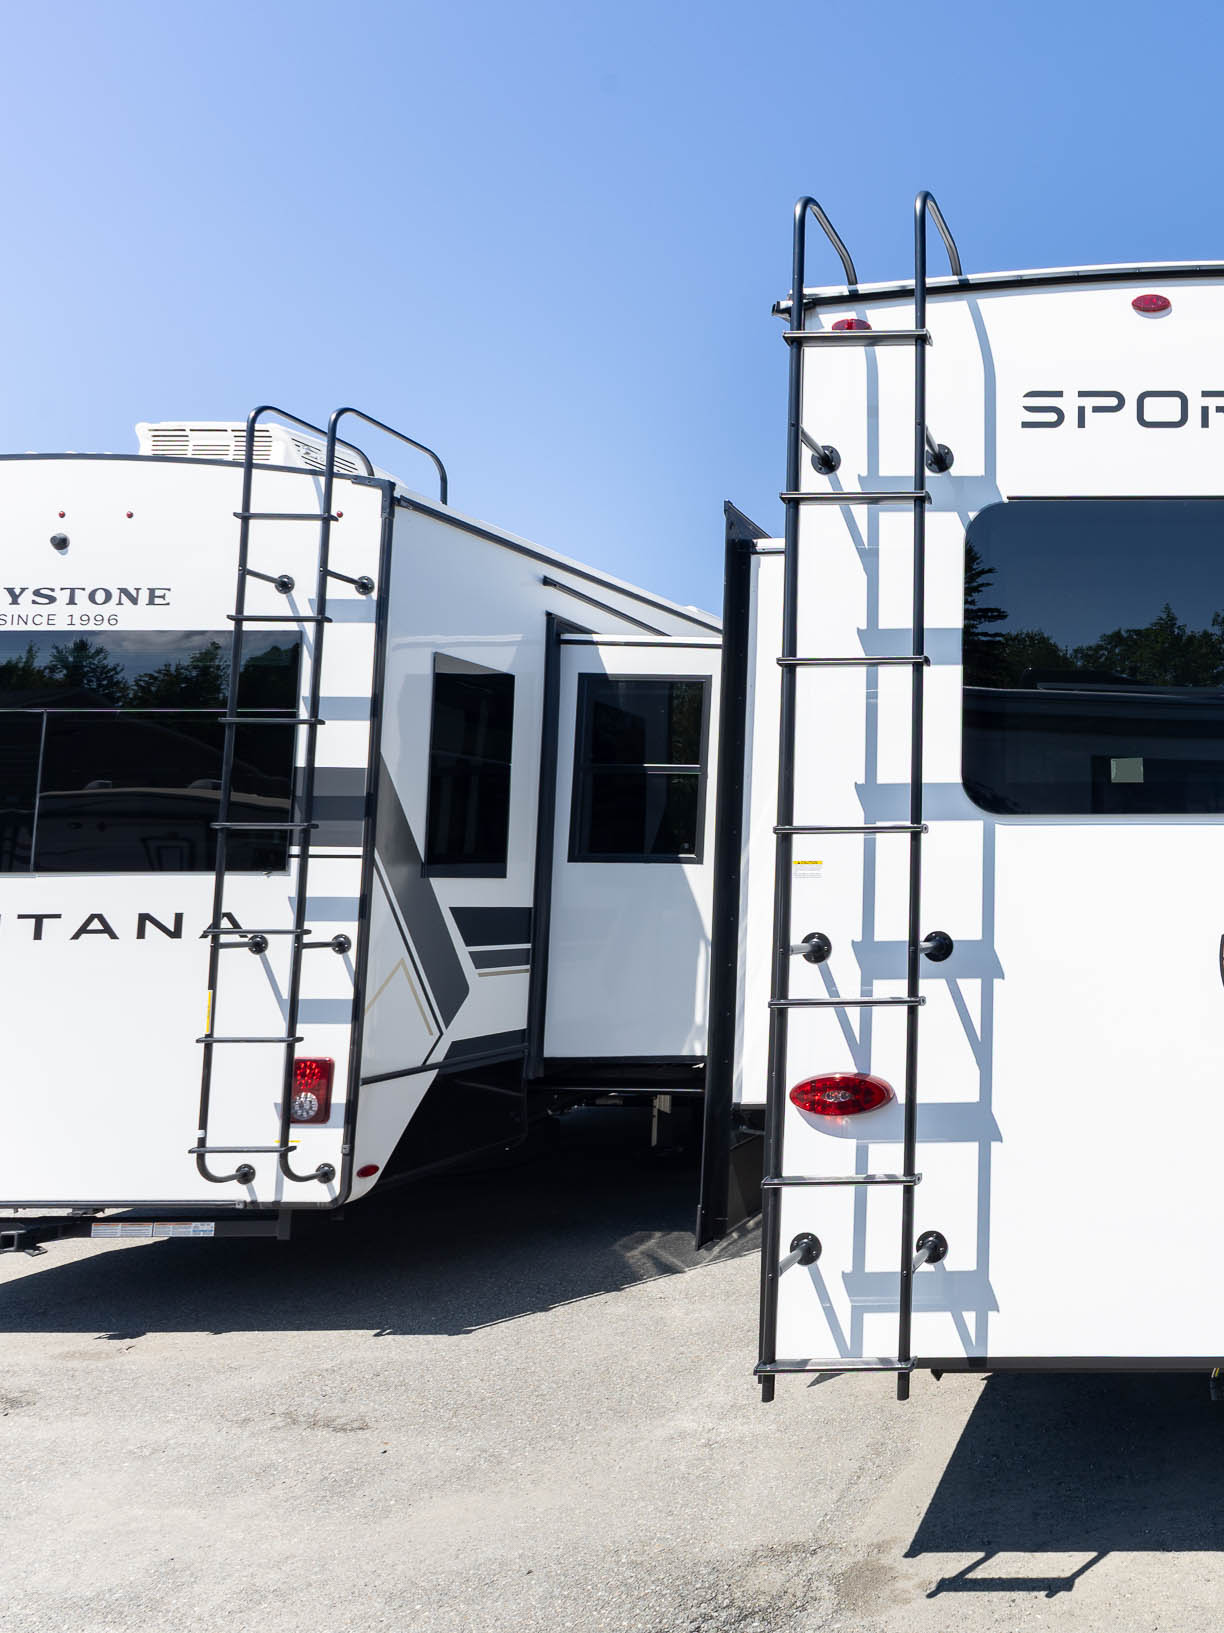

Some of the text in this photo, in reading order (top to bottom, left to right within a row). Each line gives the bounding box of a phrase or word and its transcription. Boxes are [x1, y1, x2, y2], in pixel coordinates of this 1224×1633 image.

[3, 587, 172, 606] YSTONE
[0, 614, 119, 626] SINCE 1996
[0, 912, 248, 941] TANA
